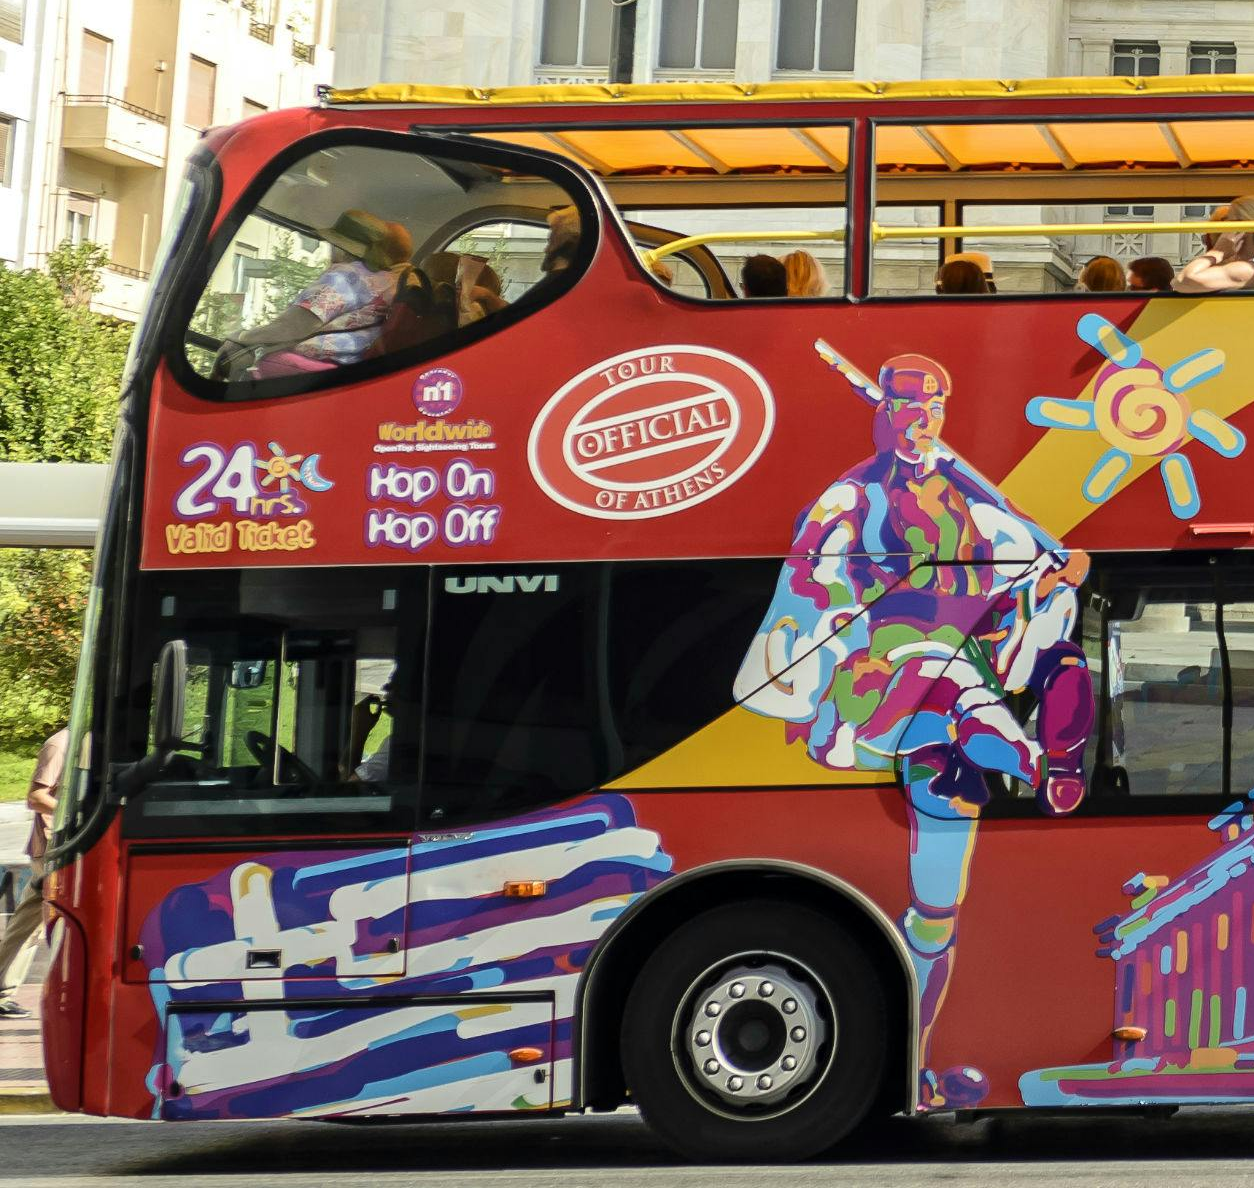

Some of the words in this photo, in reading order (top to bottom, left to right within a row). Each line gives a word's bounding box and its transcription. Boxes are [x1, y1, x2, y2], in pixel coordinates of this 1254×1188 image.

[600, 355, 676, 386] TOUR
[378, 419, 491, 440] Worldwide
[469, 441, 496, 450] Tours
[576, 402, 726, 458] OFFICIAL
[370, 466, 437, 503] Hop
[446, 461, 491, 497] On
[595, 490, 628, 509] OF
[634, 462, 727, 509] ATHENS
[165, 521, 233, 554] Valid
[235, 520, 317, 551] Ticket
[368, 512, 434, 549] Hop
[444, 507, 500, 543] Off
[444, 574, 560, 595] UNVI
